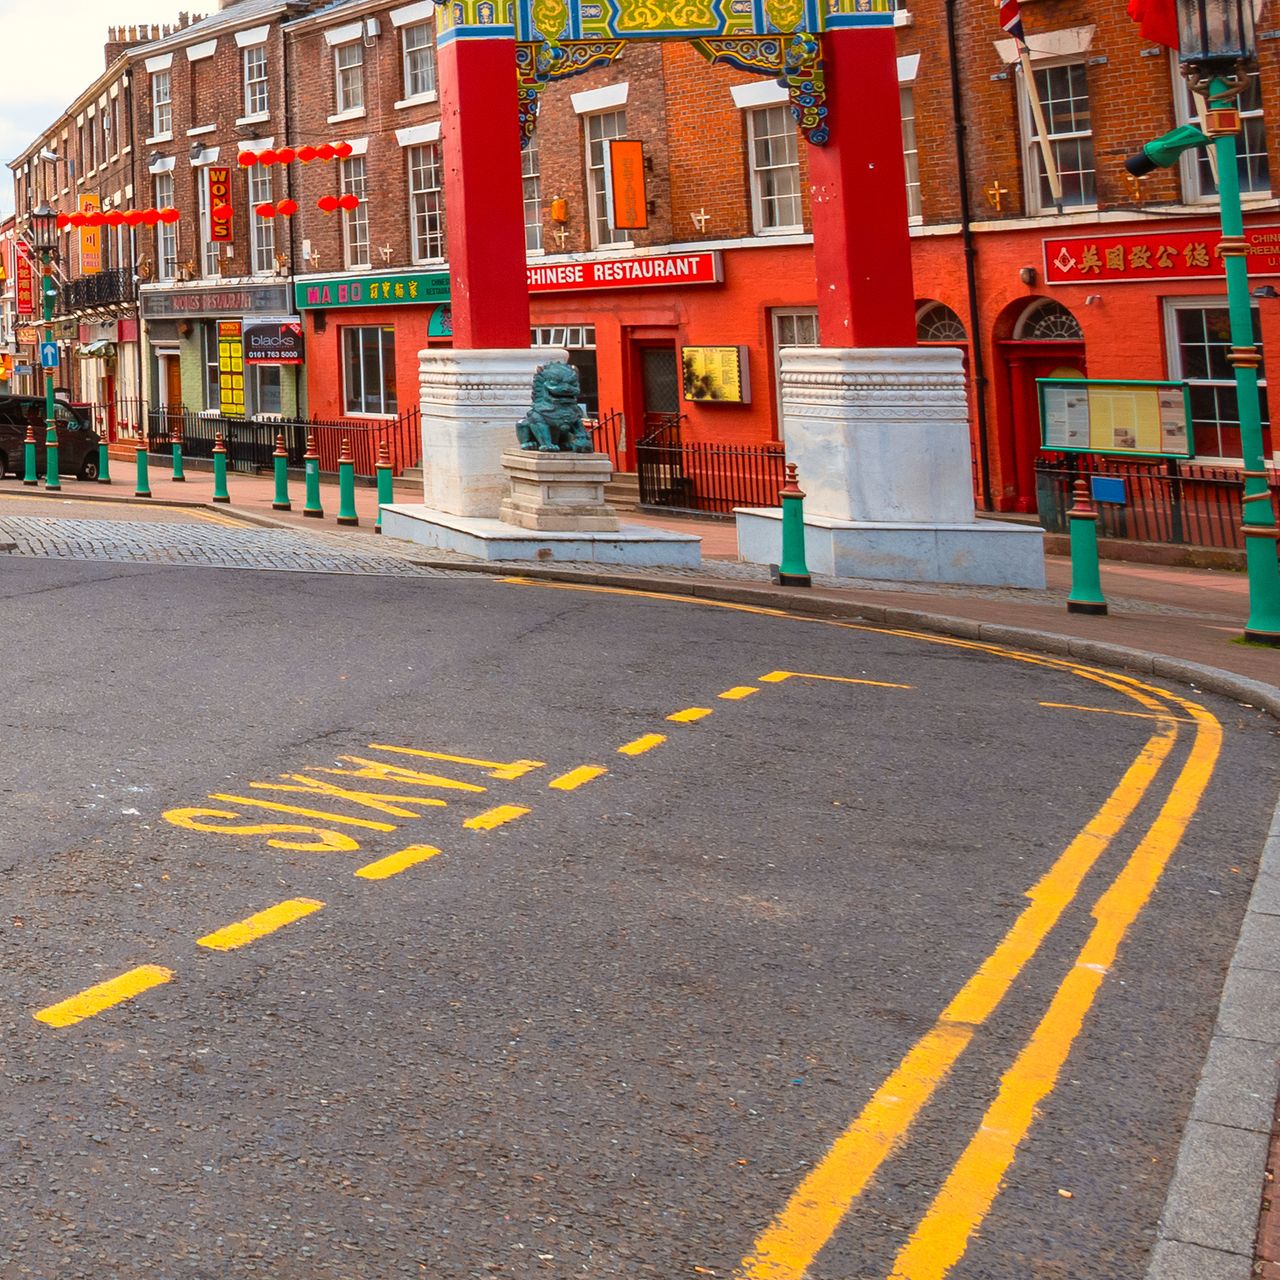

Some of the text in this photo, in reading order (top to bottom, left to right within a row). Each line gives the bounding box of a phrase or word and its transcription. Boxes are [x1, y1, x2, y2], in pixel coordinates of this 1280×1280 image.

[210, 170, 228, 236] WONS
[1251, 233, 1280, 244] CHIN
[1244, 246, 1280, 256] FREEM
[594, 257, 700, 281] RESTAURANT
[307, 285, 332, 304] MA
[251, 327, 295, 346] blacks
[161, 742, 546, 852] TAXIS
